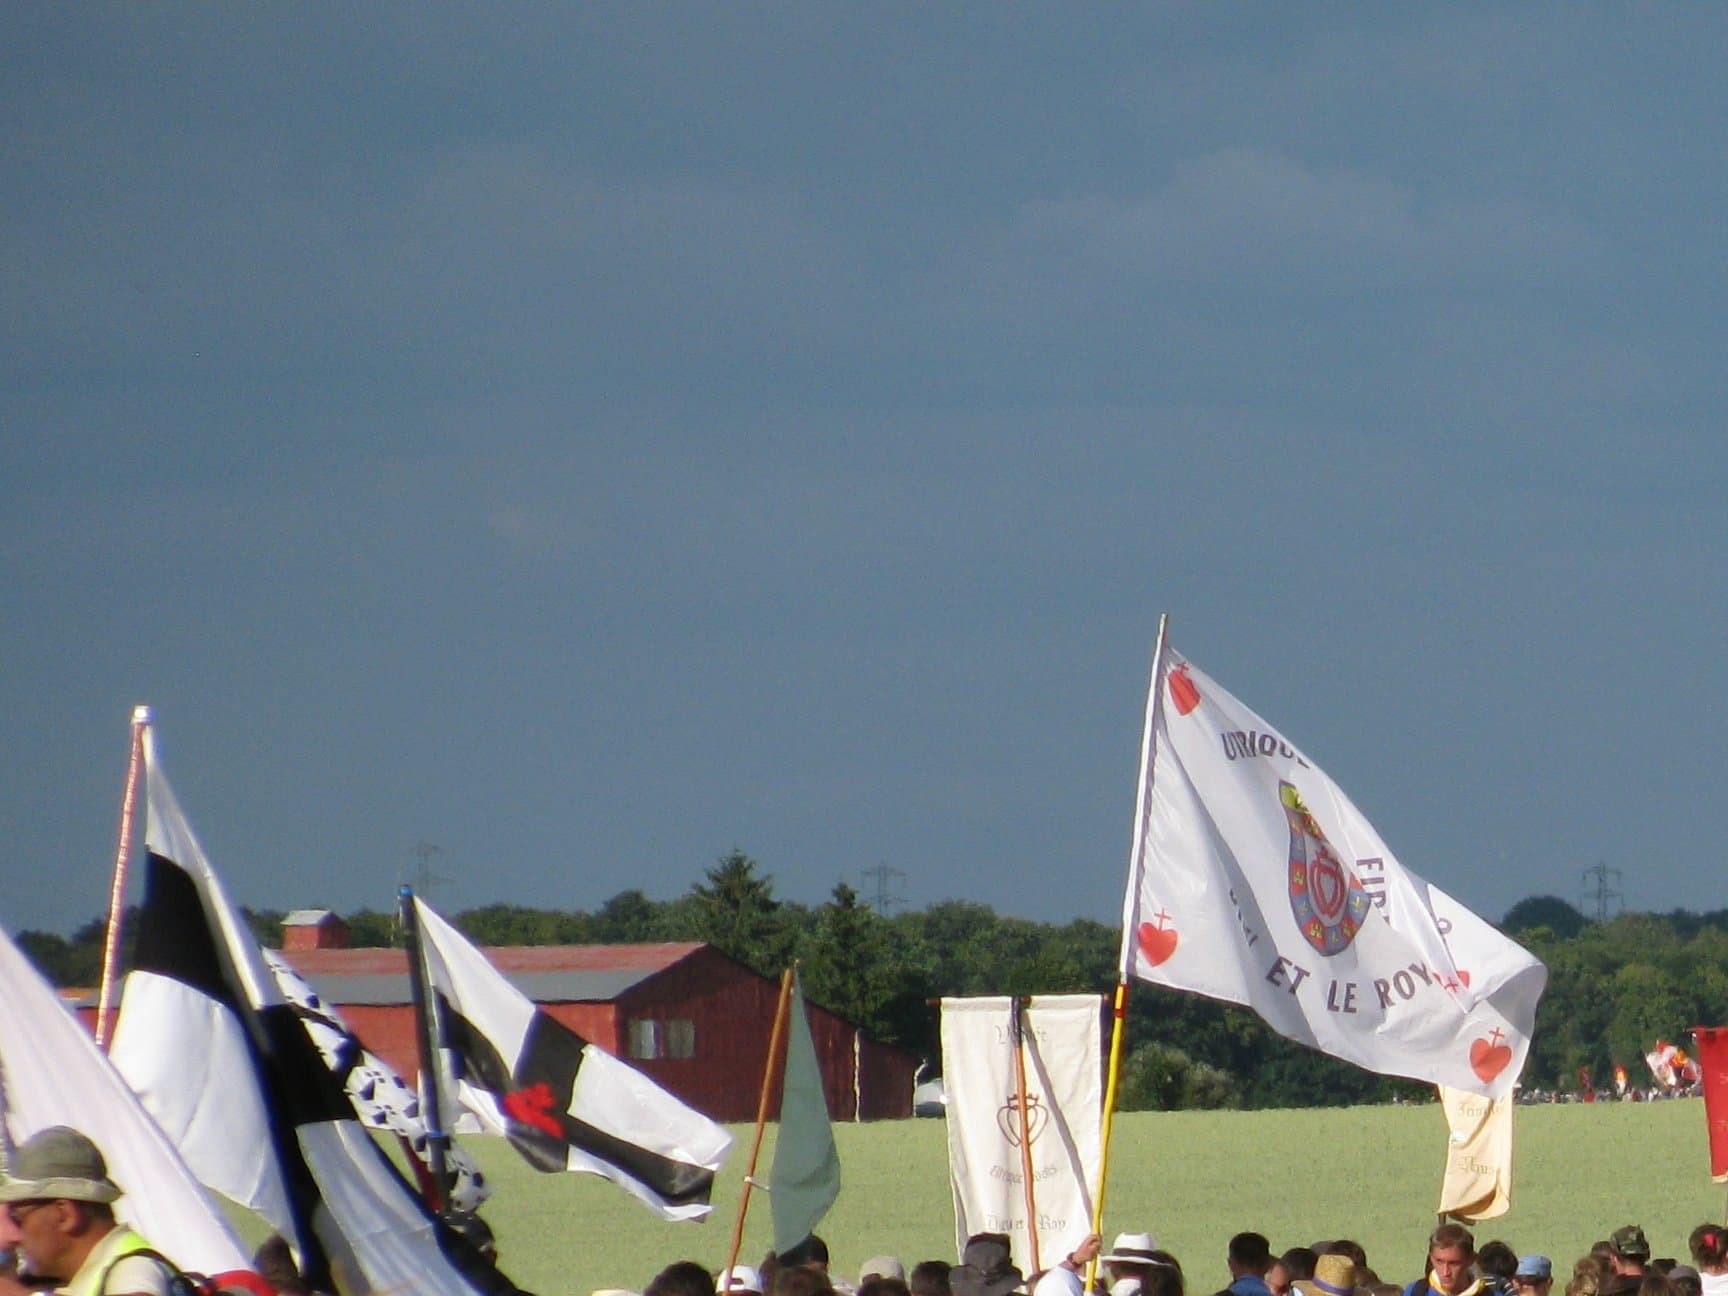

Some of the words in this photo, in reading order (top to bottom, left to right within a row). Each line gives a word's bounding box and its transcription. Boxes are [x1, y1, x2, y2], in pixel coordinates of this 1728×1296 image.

[1265, 955, 1310, 996] ET
[1327, 979, 1358, 1014] LE
[1373, 959, 1433, 1010] ROY
